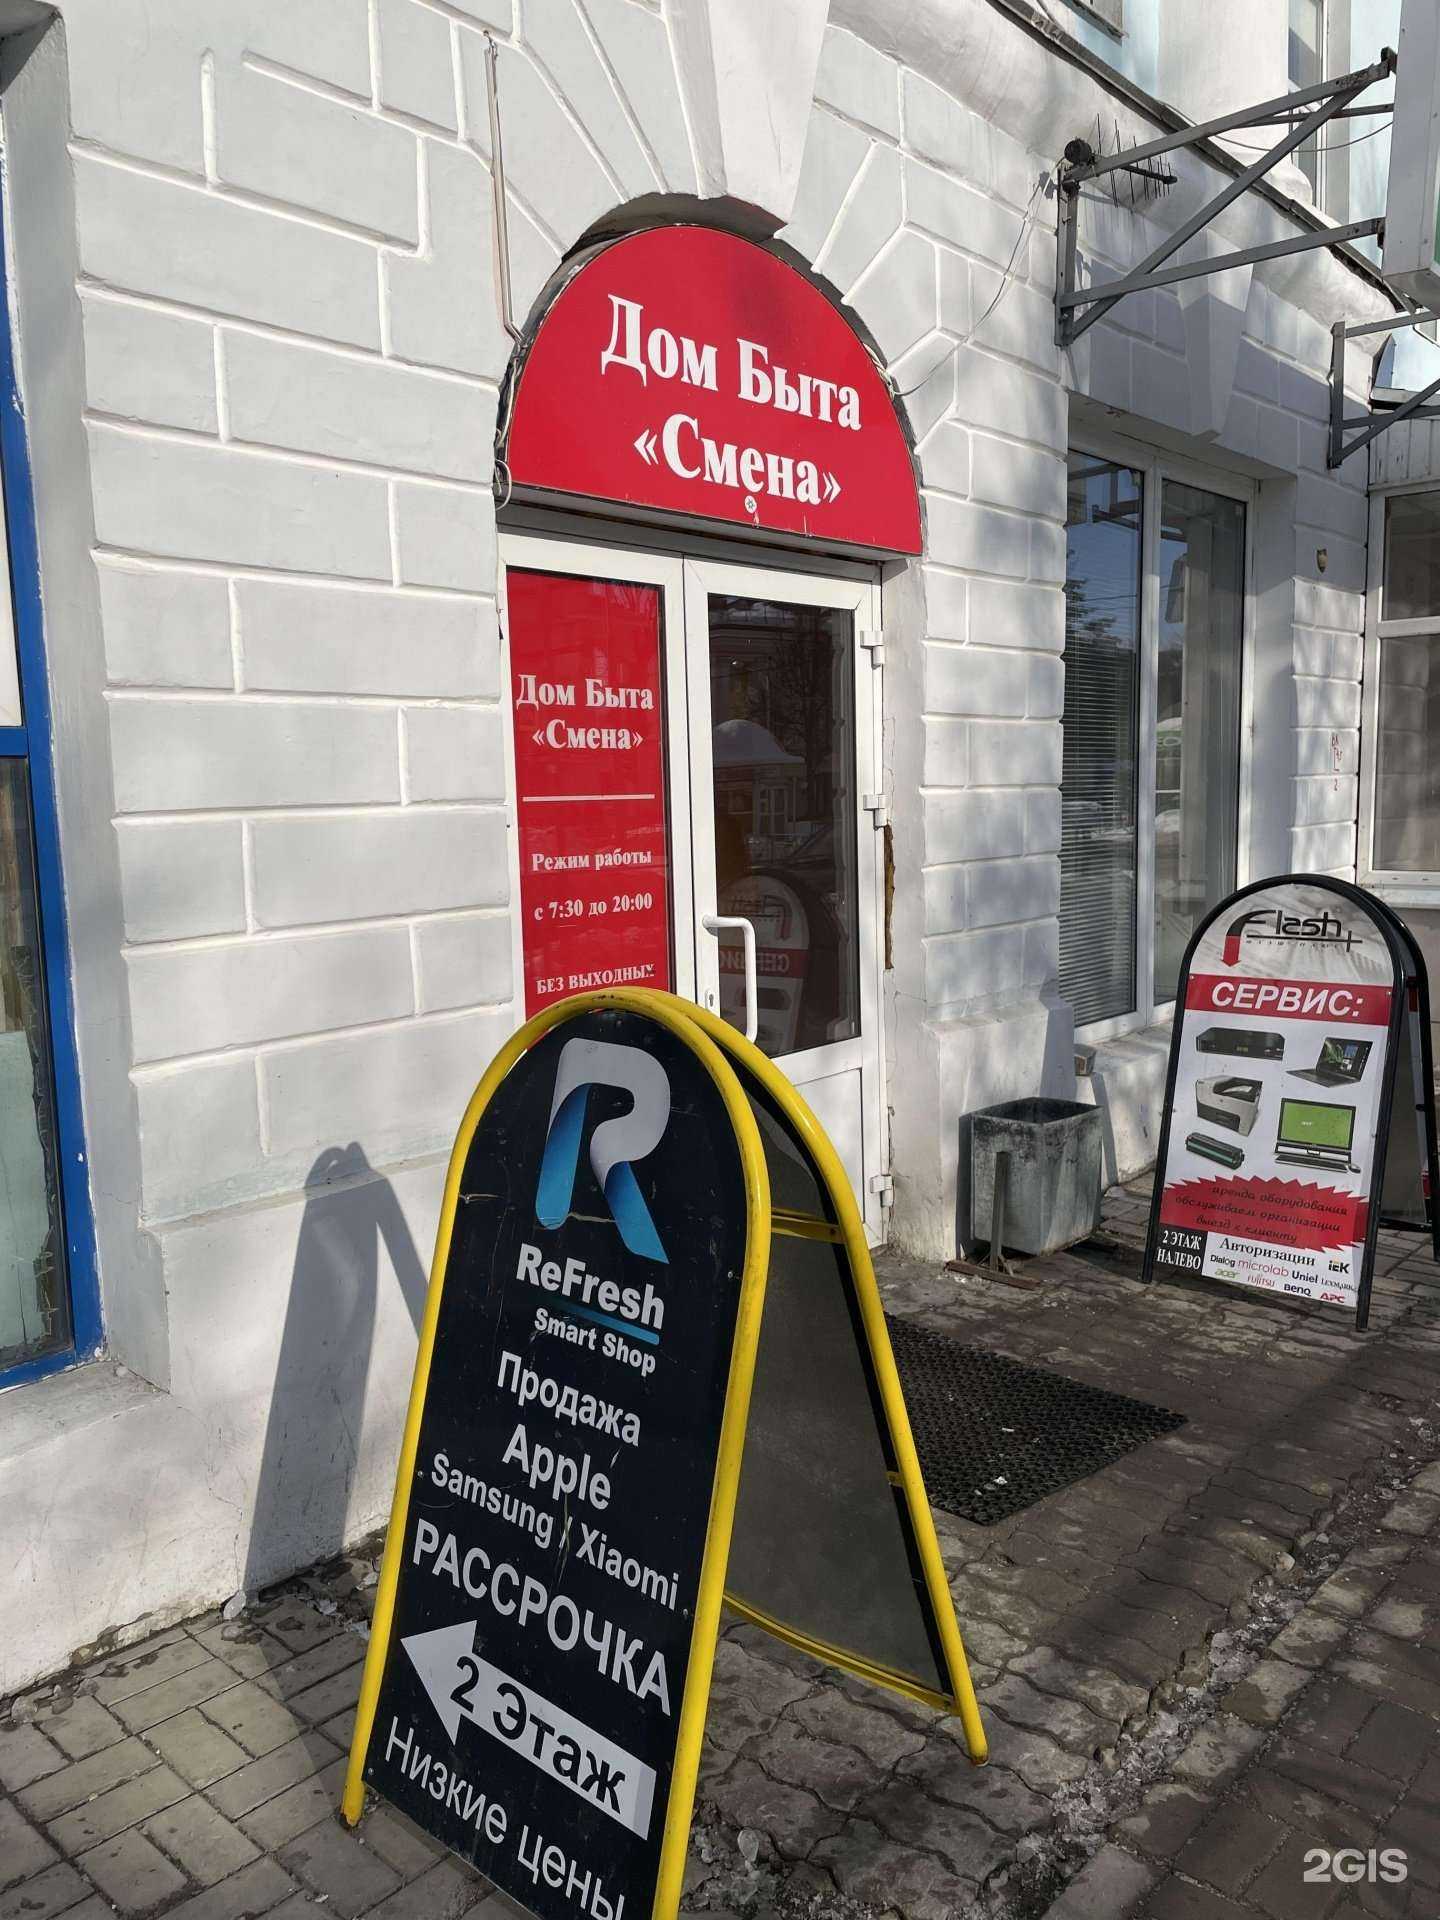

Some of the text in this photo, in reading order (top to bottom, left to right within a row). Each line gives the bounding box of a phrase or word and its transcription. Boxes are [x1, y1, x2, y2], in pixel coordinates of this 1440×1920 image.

[601, 294, 861, 431] Дом Быта
[633, 413, 842, 505] «Смена»
[516, 674, 654, 711] Дом Быта
[532, 718, 643, 749] «Смена»
[532, 848, 652, 872] Режим работы
[534, 893, 653, 921] с 7:30 до 20:00
[536, 977, 565, 994] БЕЗ
[1212, 981, 1364, 1017] СЕРВИС:
[1259, 1191, 1348, 1216] оборудования
[1162, 1230, 1202, 1250] 2 ЭТАЖ
[1260, 1211, 1341, 1233] организации
[1156, 1249, 1201, 1270] НАЛЕВО
[1210, 1254, 1236, 1268] Dialog
[1237, 1259, 1289, 1277] microlab
[1292, 1270, 1318, 1284] Uniel
[1219, 1237, 1316, 1267] Авторизации
[516, 1243, 665, 1330] ReFresh
[1214, 1268, 1240, 1279] acer
[1320, 1292, 1345, 1304] APC
[534, 1307, 656, 1377] Smart Shop
[497, 1350, 641, 1447] Продажа
[502, 1423, 611, 1510] Apple
[432, 1453, 553, 1549] Samsung
[576, 1522, 679, 1611] Xiaomi
[412, 1518, 671, 1717] РАССРОЧКА
[450, 1656, 626, 1815] 2 Этаж
[385, 1715, 625, 1920] Низкие цены
